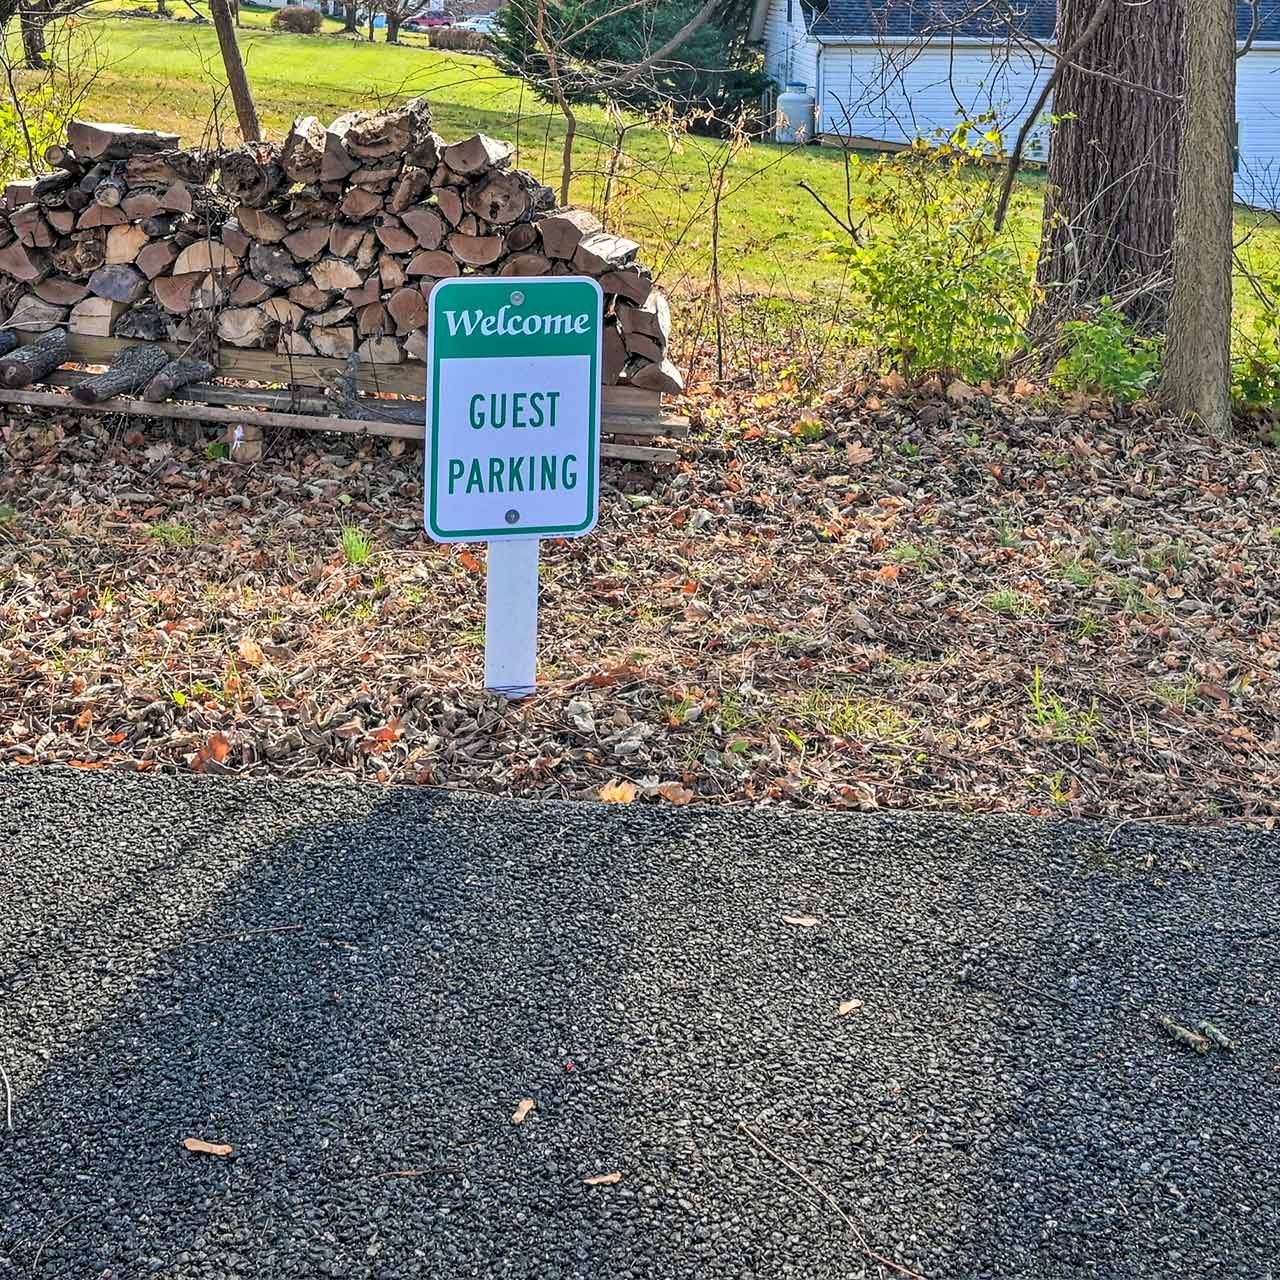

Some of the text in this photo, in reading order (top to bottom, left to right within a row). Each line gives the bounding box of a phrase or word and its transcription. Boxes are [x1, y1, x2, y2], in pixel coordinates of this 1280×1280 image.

[443, 304, 591, 337] Welcome
[469, 391, 561, 430] GUEST
[448, 453, 578, 495] PARKING
